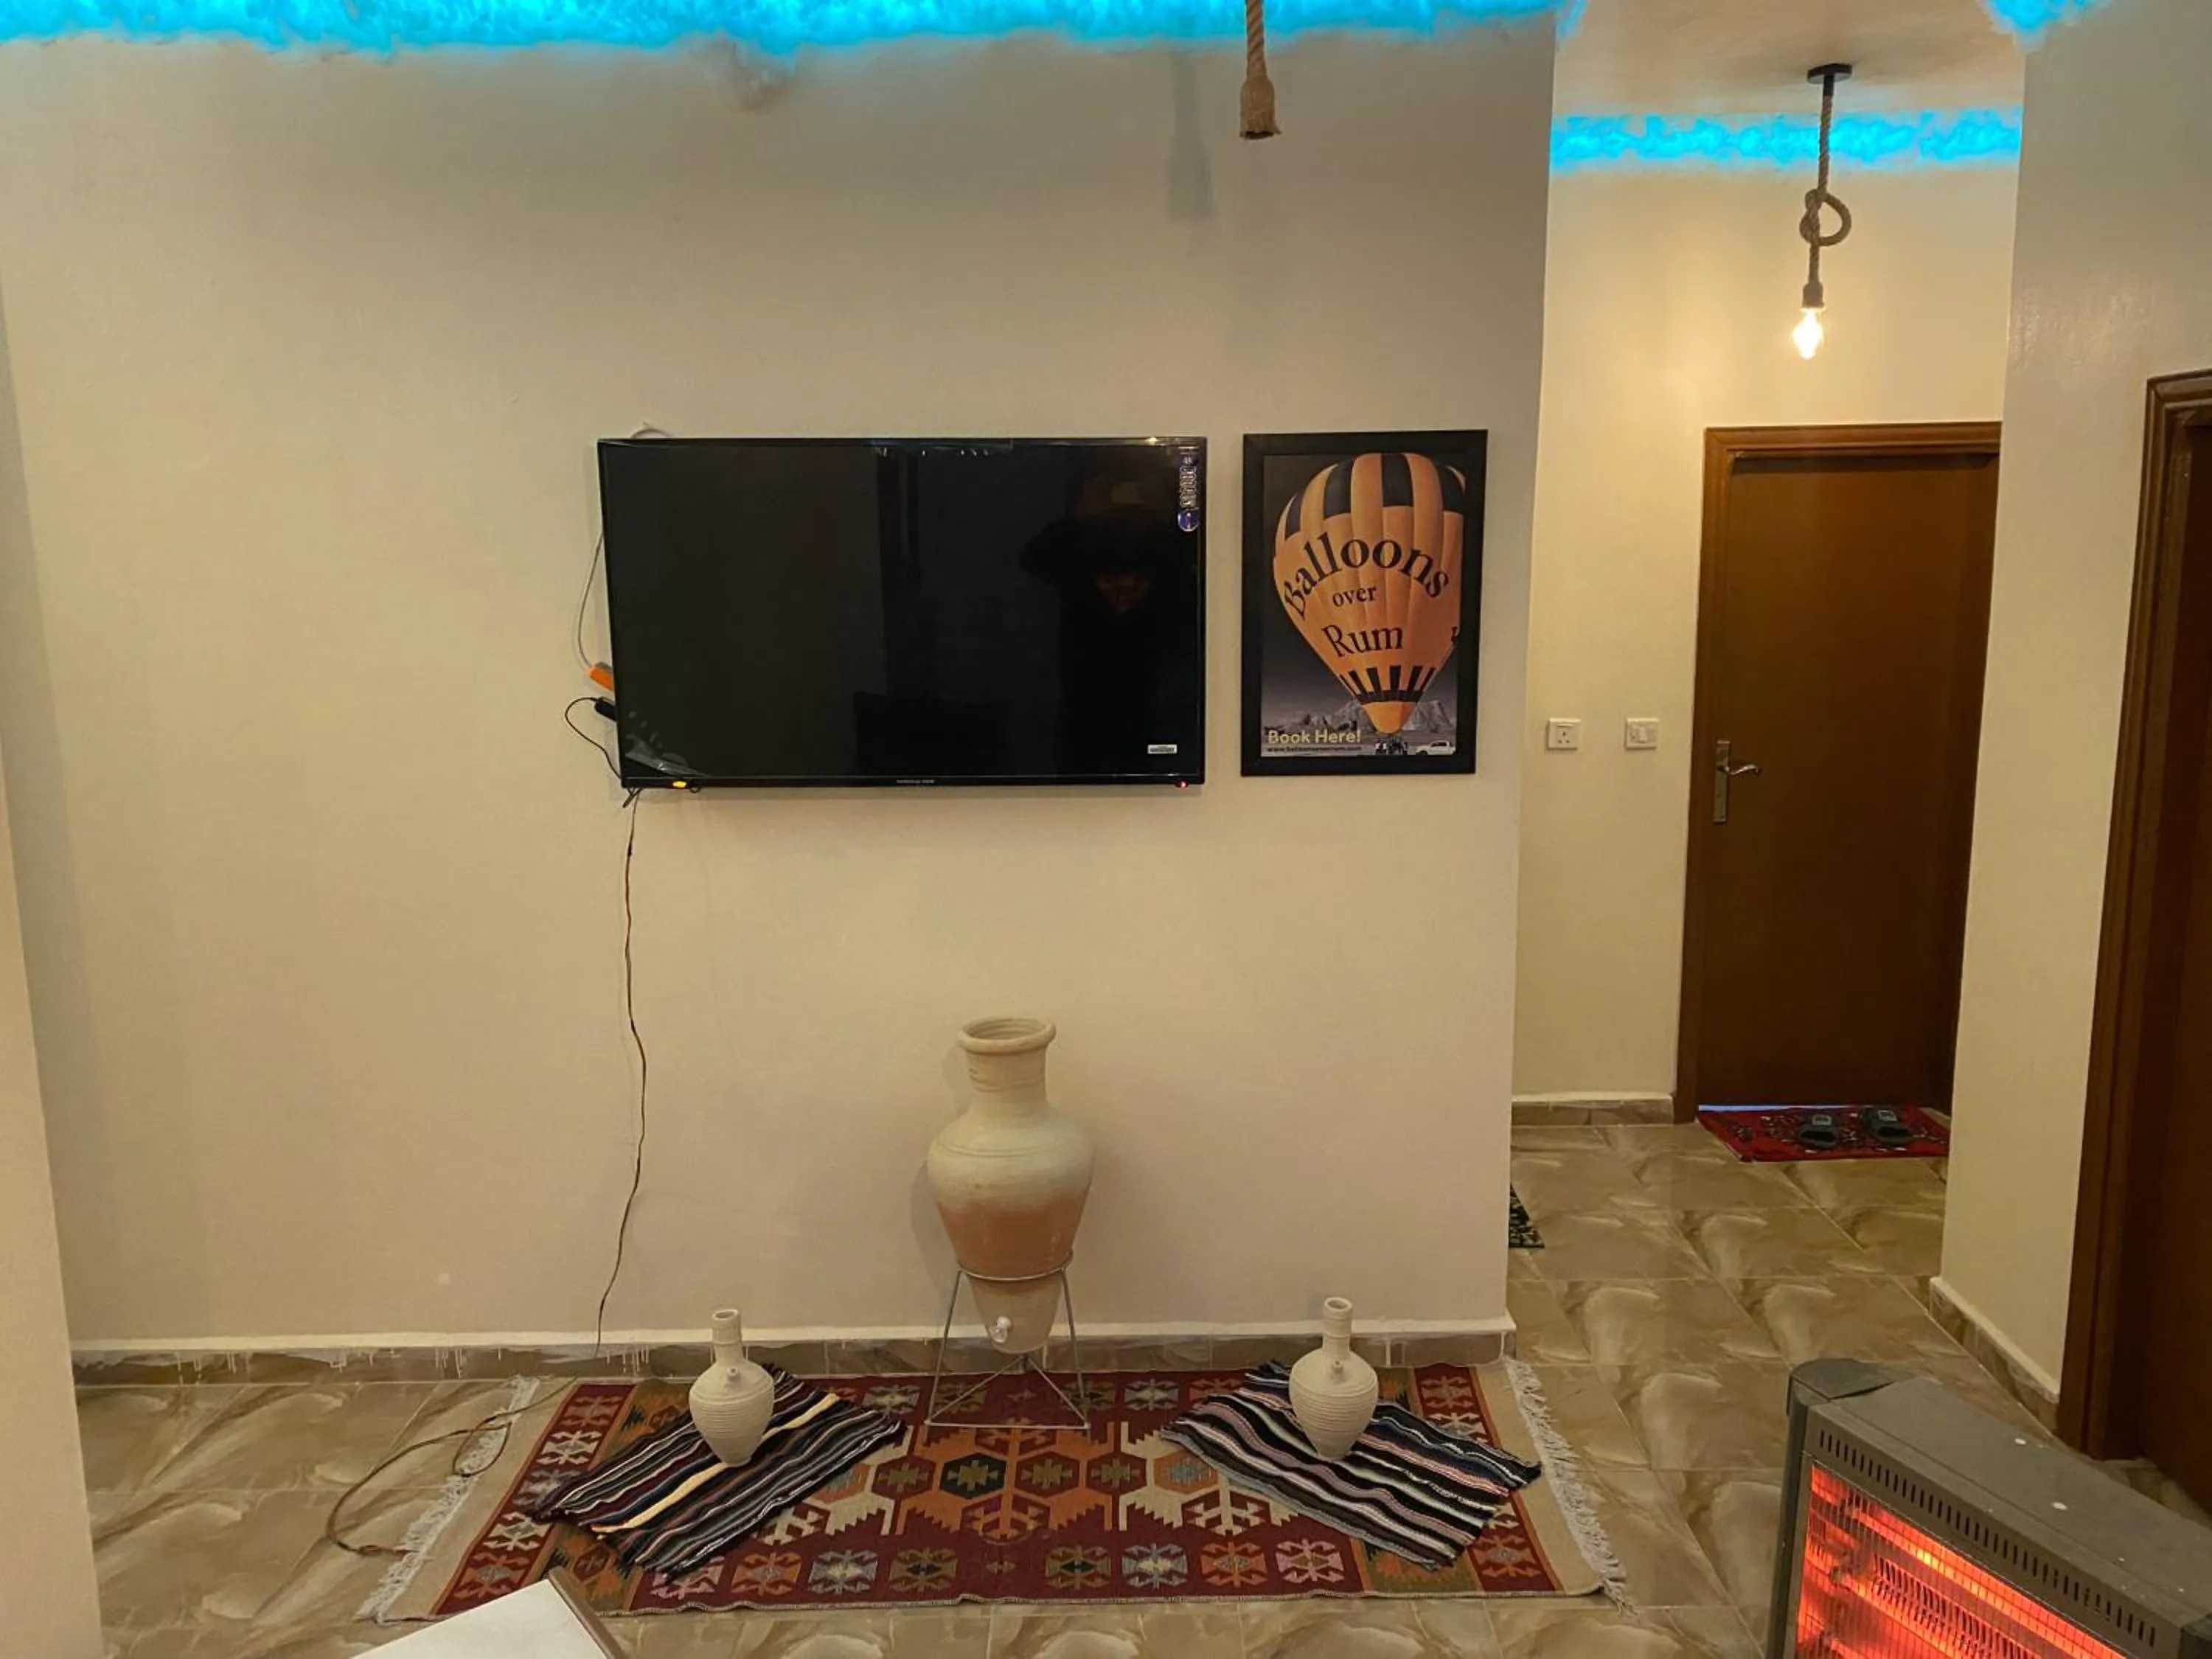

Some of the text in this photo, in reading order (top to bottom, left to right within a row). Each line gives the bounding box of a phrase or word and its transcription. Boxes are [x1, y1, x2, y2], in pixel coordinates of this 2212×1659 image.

[1283, 532, 1449, 621] Balloons
[1332, 585, 1377, 607] over
[1322, 624, 1403, 658] Rum
[1267, 728, 1361, 744] Book Here!
